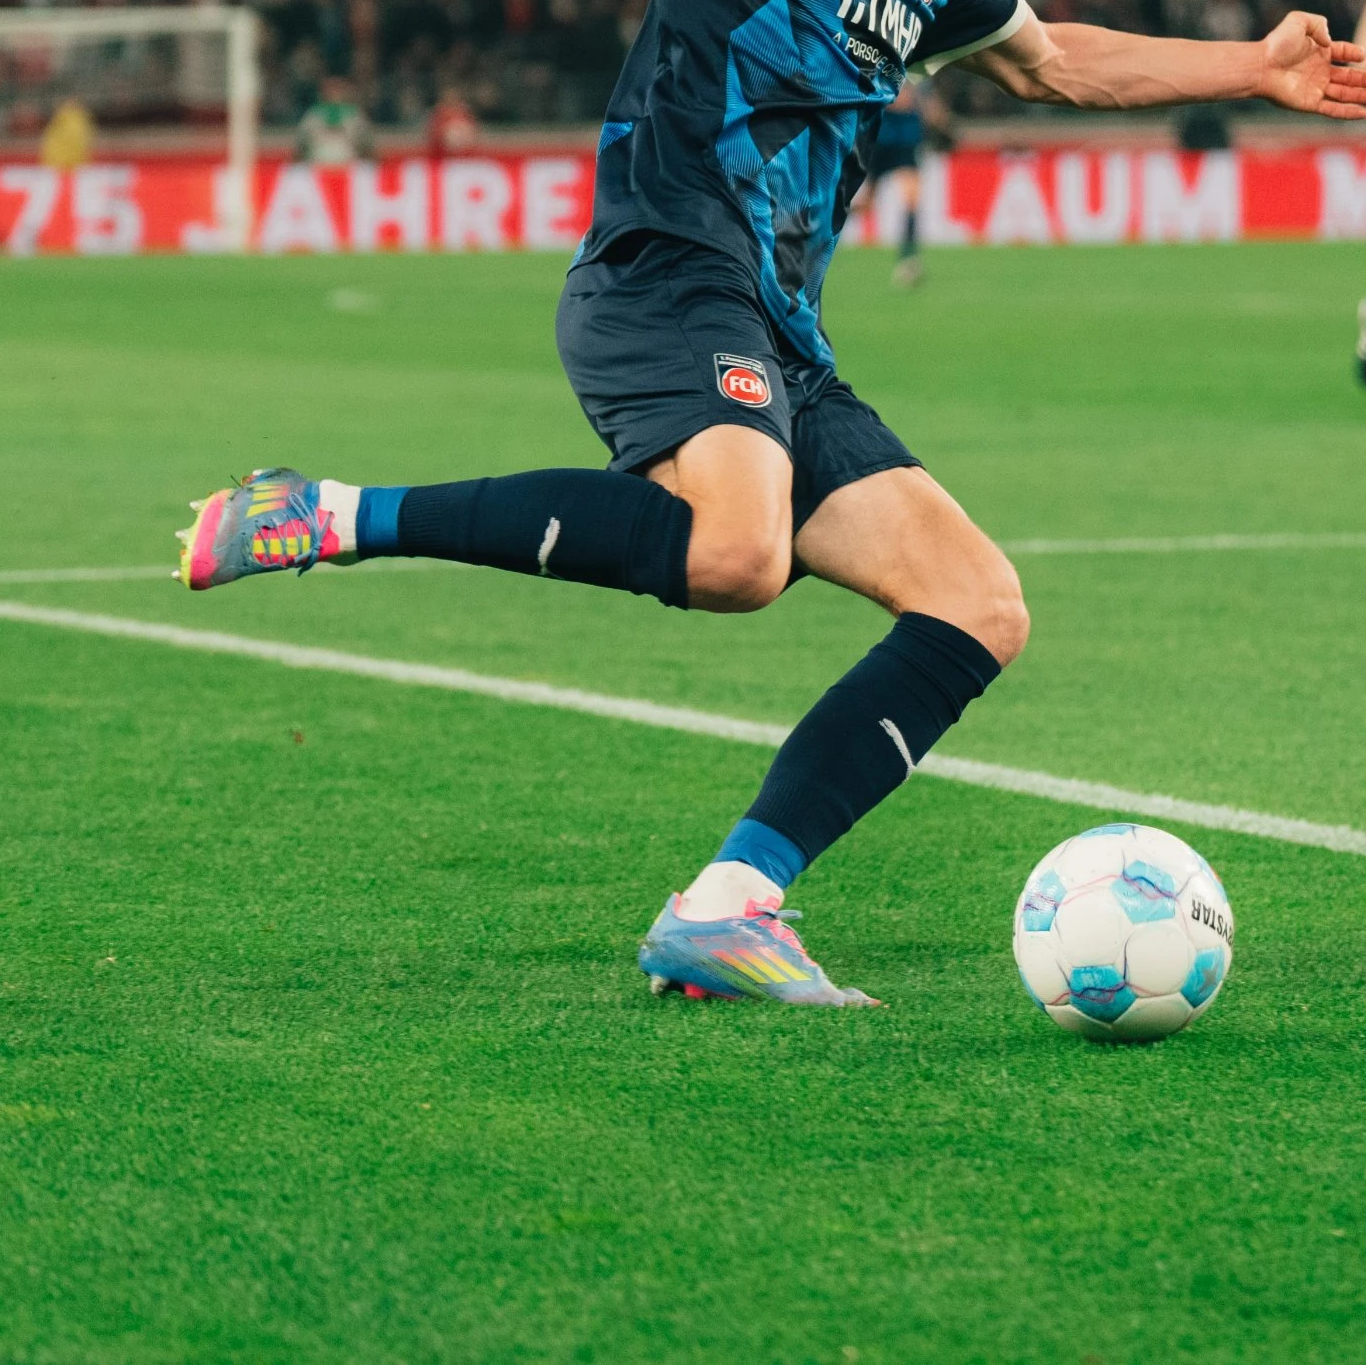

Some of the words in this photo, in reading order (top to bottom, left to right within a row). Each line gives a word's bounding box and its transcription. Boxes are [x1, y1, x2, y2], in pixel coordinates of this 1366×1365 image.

[844, 36, 888, 70] PORSCE
[180, 157, 585, 253] JAHRE
[729, 375, 764, 396] FCH
